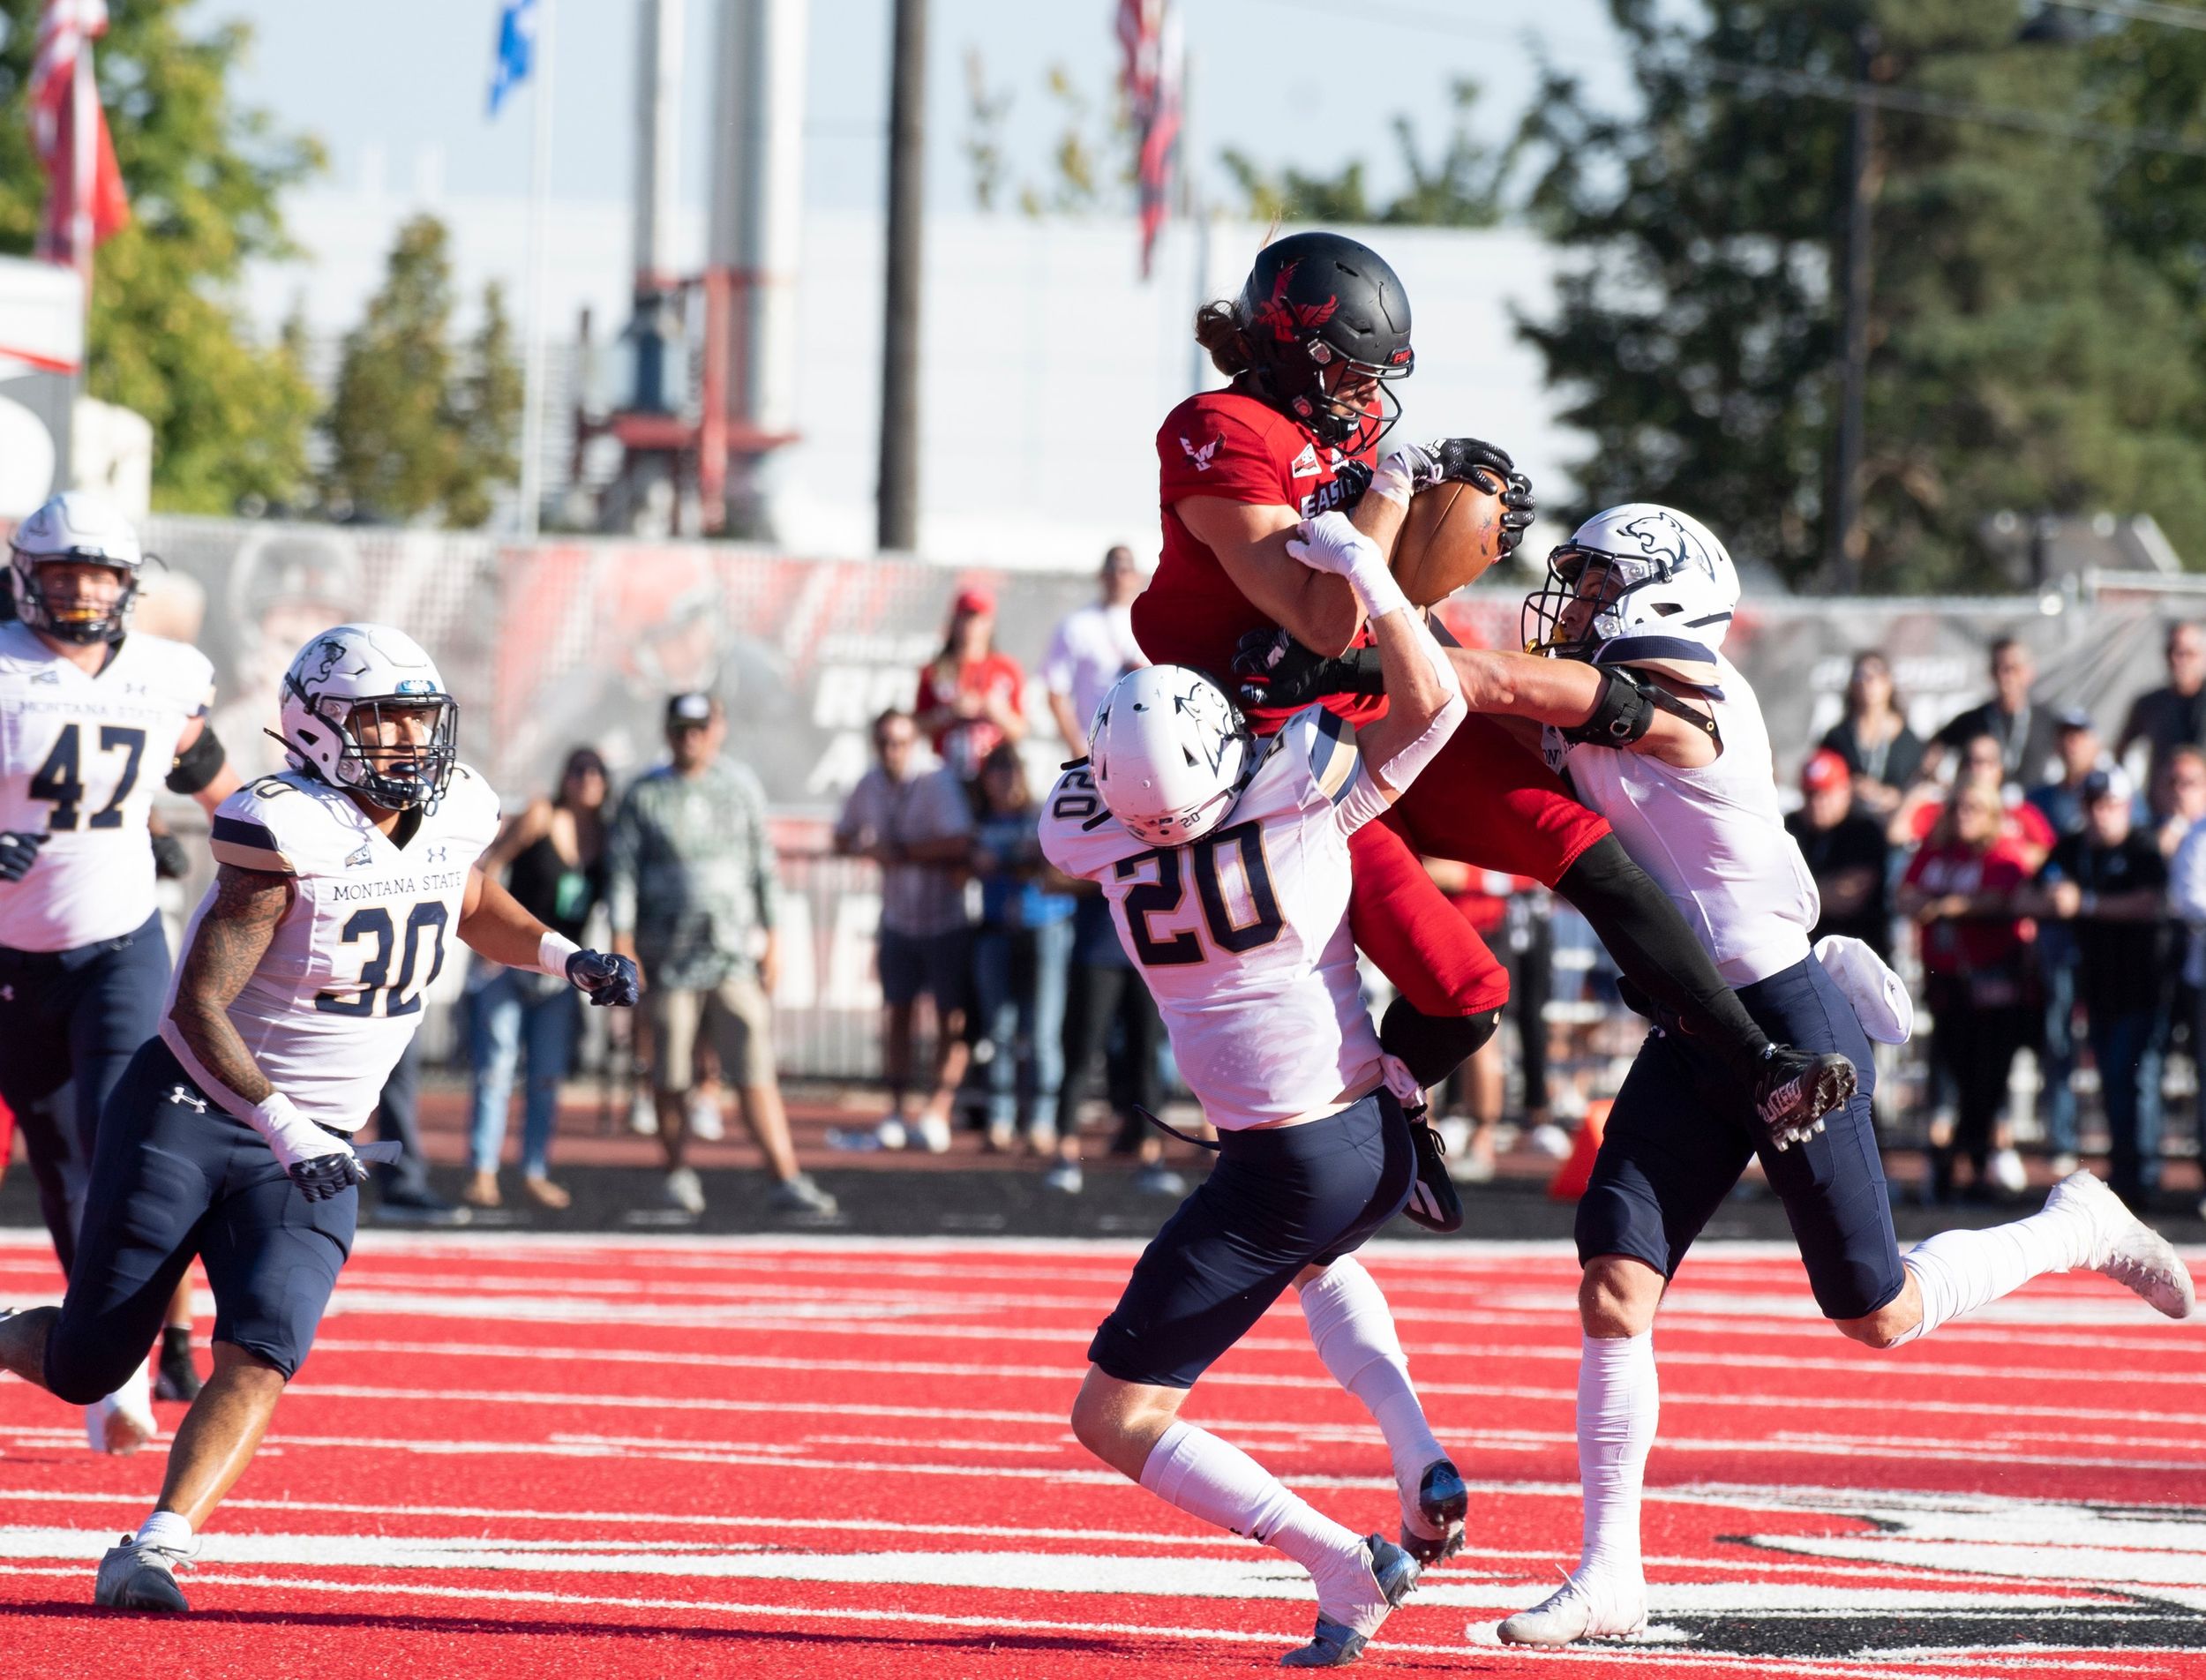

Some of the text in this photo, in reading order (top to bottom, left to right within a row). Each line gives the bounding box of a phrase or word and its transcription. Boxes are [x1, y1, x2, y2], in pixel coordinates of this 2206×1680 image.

[27, 723, 146, 832] 47
[1181, 811, 1201, 829] 20
[333, 871, 461, 901] MONTANA STATE
[1114, 819, 1287, 968] 20
[314, 901, 448, 1016] 30
